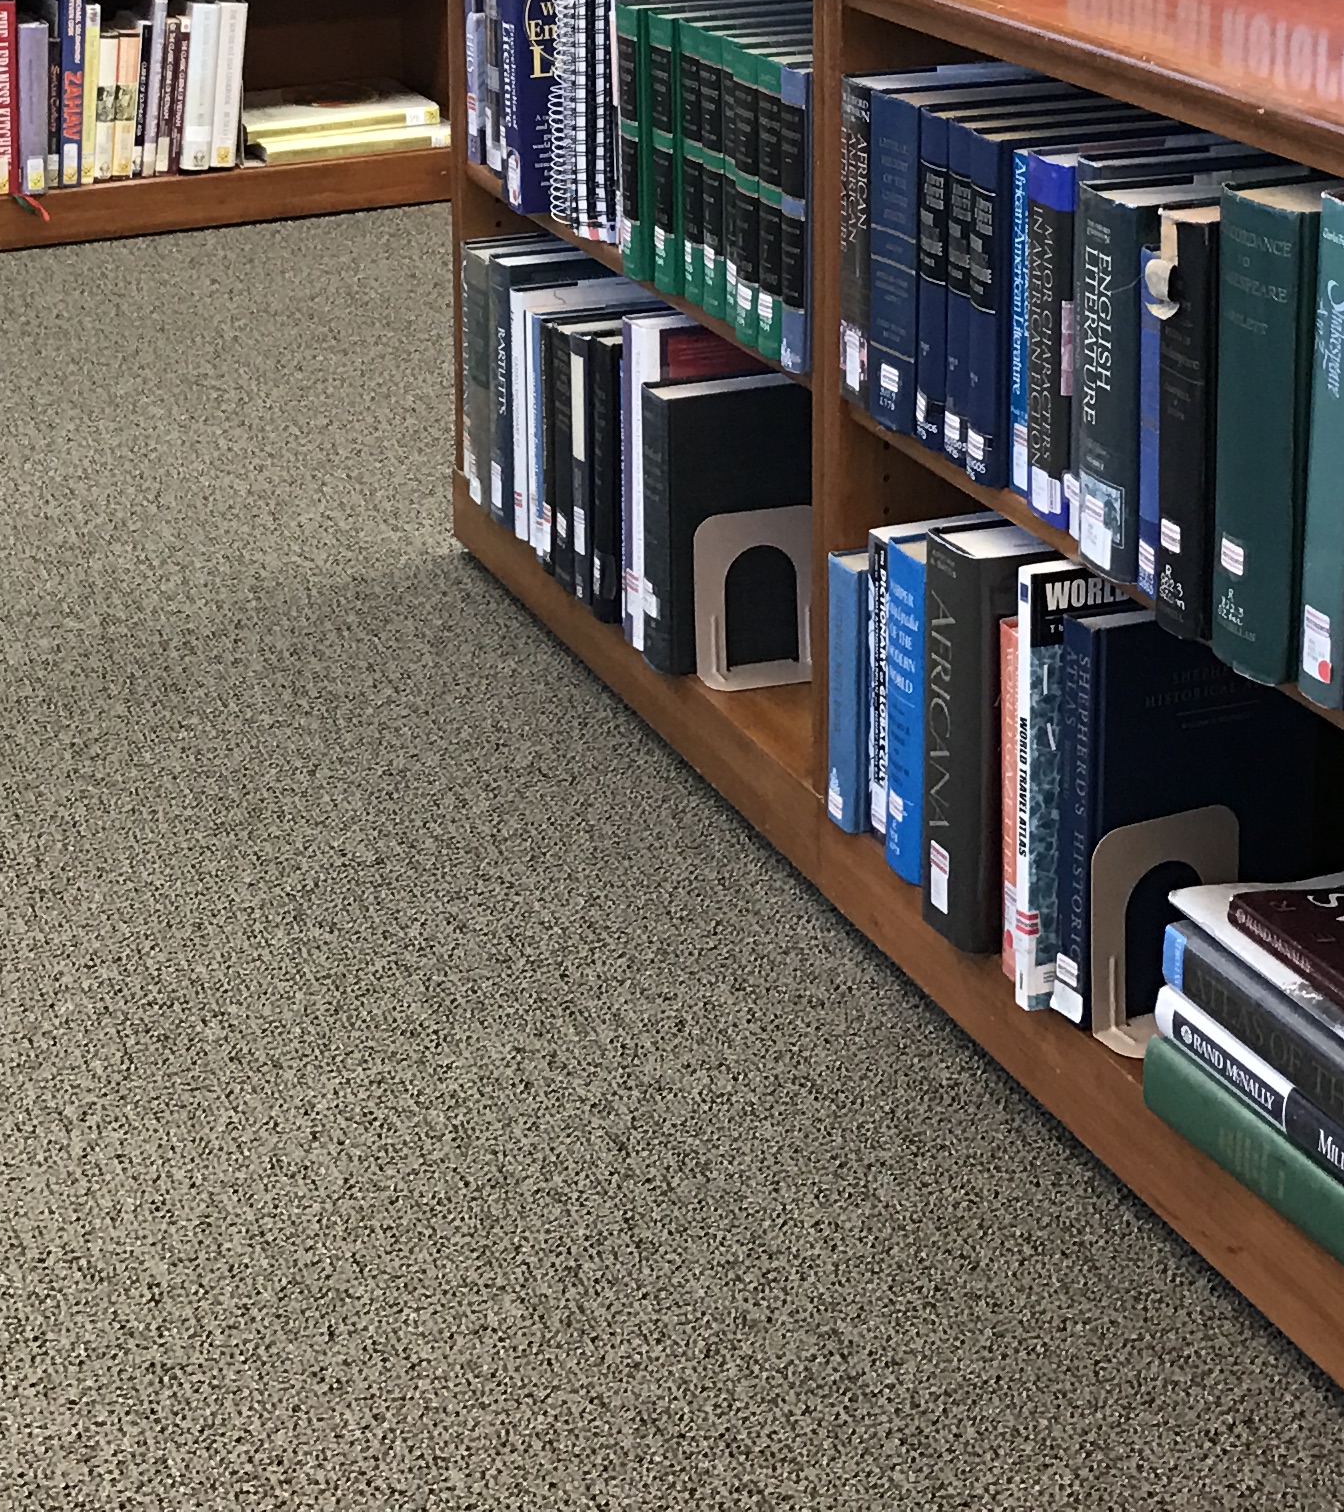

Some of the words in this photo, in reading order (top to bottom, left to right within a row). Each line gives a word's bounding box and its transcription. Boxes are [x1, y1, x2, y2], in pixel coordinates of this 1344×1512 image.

[63, 70, 83, 140] ZAHAV
[501, 20, 513, 128] Literature
[847, 131, 857, 243] AMERICAN
[857, 133, 868, 230] AFRICAN
[1032, 207, 1044, 232] IN
[1012, 155, 1027, 310] African-American
[1043, 224, 1053, 302] MAJOR
[1031, 238, 1043, 370] AMERICAN
[1083, 245, 1098, 426] LITERATURE
[1097, 252, 1112, 392] ENGLISH
[1012, 314, 1025, 395] Literature
[1040, 309, 1053, 462] CHARACTERS
[1030, 377, 1042, 467] FICTION
[929, 589, 957, 828] AFRICANA
[1064, 648, 1077, 726] ATLAS
[1018, 717, 1028, 764] WORLD
[1018, 768, 1028, 815] TRAVEL
[1018, 817, 1027, 857] ATLAS
